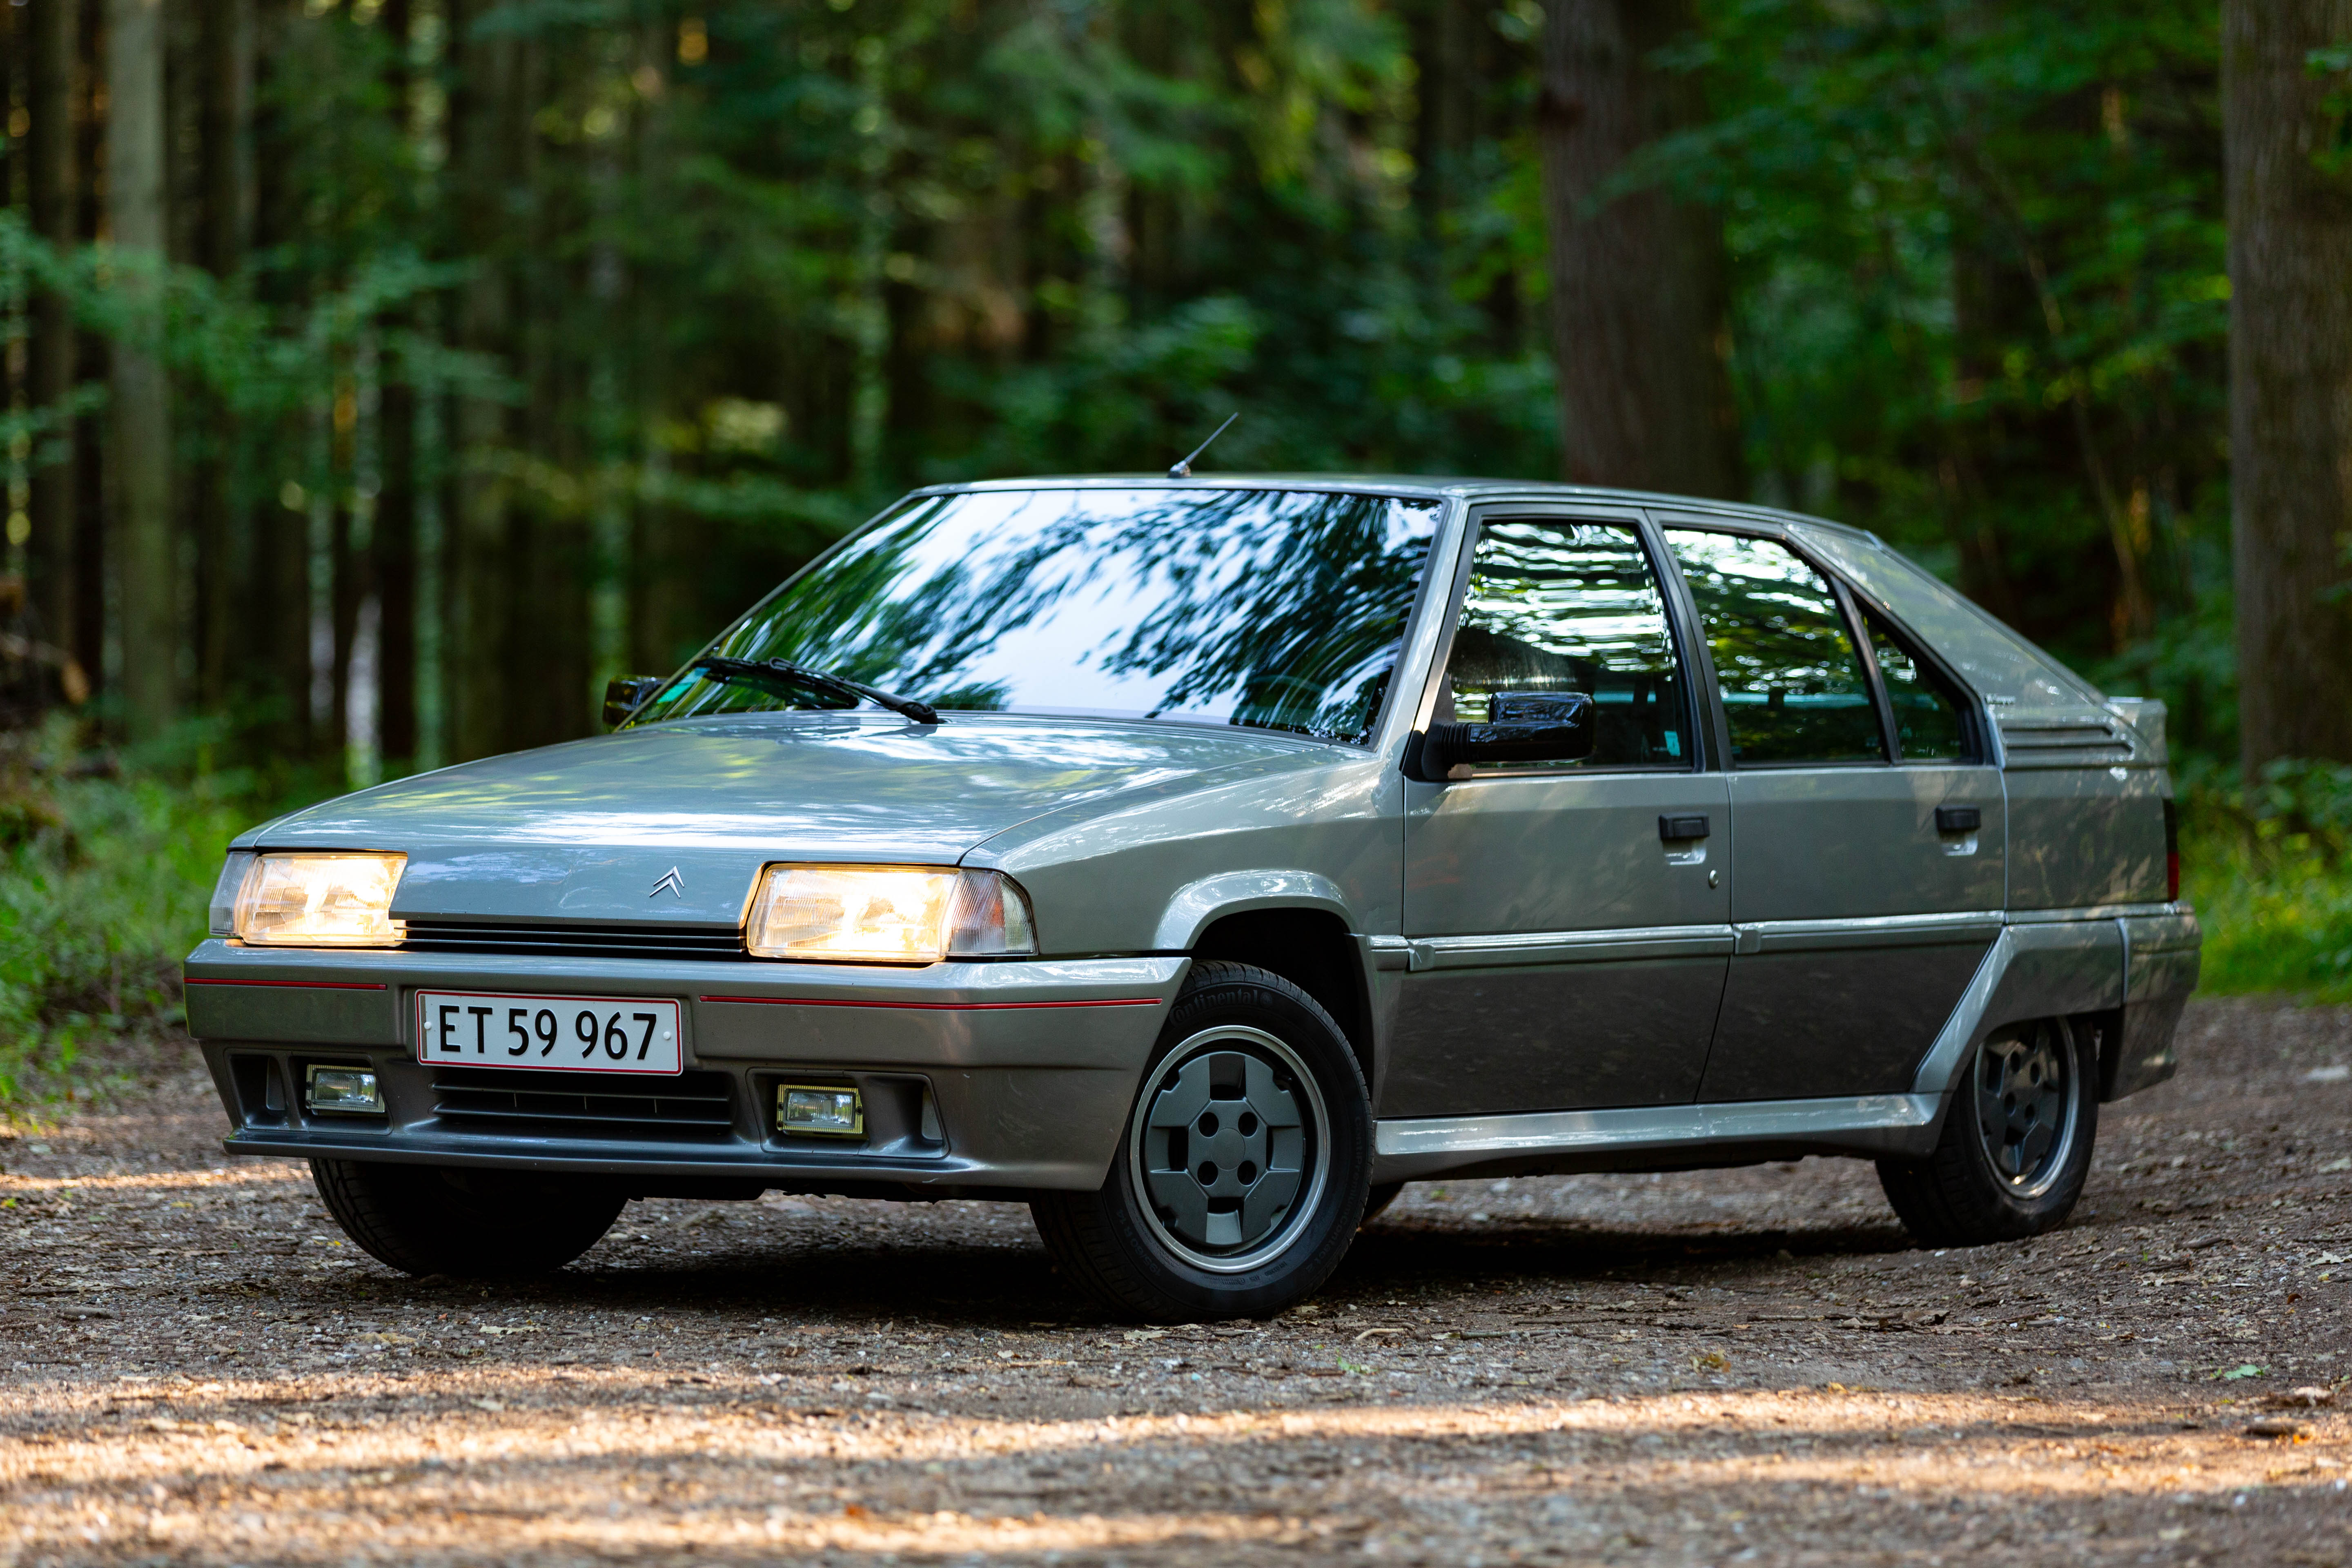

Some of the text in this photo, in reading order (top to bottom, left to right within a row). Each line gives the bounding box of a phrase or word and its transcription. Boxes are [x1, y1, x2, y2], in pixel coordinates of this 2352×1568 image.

[1169, 989, 1258, 1027] Continental
[439, 1005, 657, 1060] ET 59 967
[1305, 1116, 1363, 1273] ContiPremiumContact 2
[1116, 1209, 1127, 1225] 14
[1124, 1226, 1133, 1238] R
[1130, 1238, 1161, 1276] 195/60
